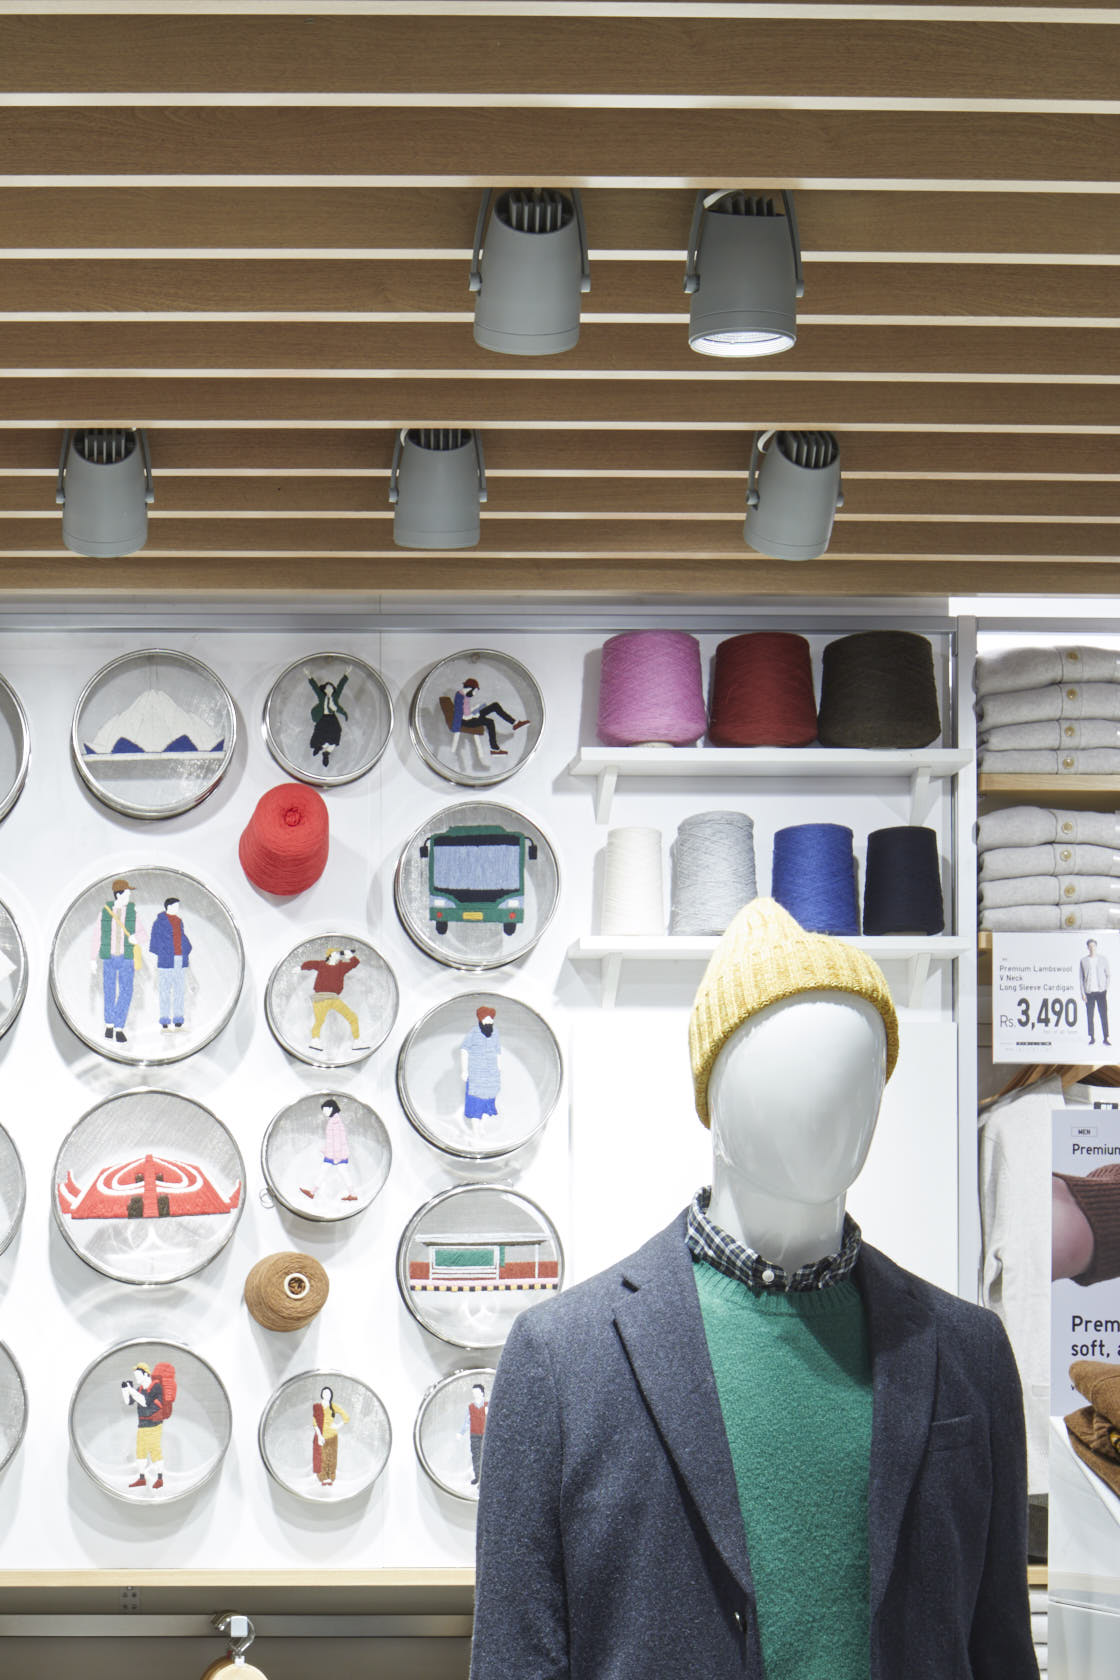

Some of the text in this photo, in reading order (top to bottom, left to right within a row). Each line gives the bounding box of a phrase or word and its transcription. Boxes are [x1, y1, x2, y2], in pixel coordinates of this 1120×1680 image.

[999, 964, 1073, 973] Premium Lambswool
[999, 983, 1074, 993] Long Sleeve Cardigan
[1071, 1339, 1111, 1359] soft,
